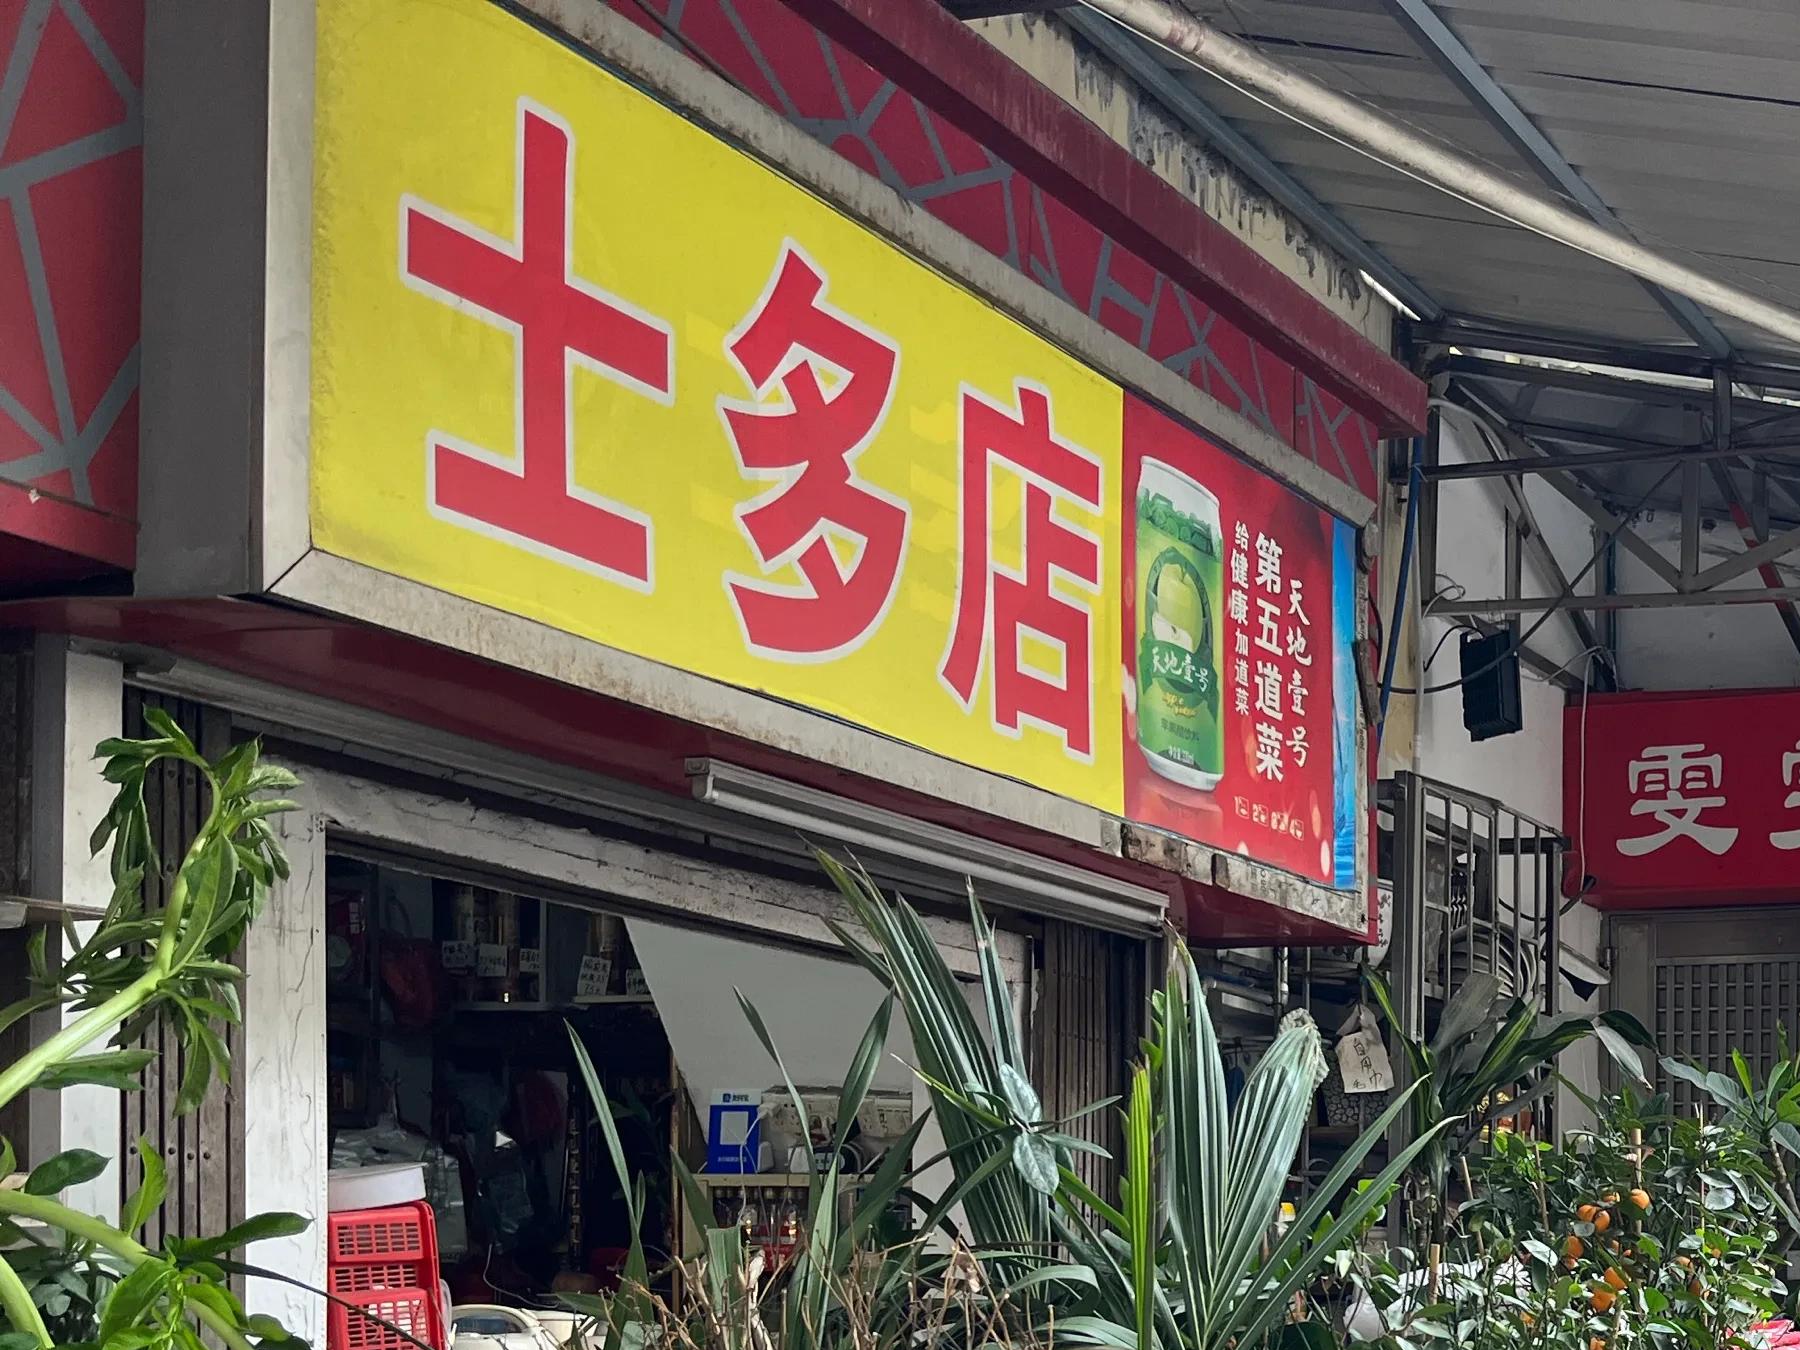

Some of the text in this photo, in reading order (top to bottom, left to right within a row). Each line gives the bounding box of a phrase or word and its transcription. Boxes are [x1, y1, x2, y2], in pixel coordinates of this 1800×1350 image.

[400, 97, 1104, 764] 士多店
[1151, 646, 1210, 693] 天地壹号
[1230, 520, 1250, 716] 给健康加道菜
[1253, 532, 1285, 782] 第五道菜
[1285, 579, 1313, 768] 天地壹号
